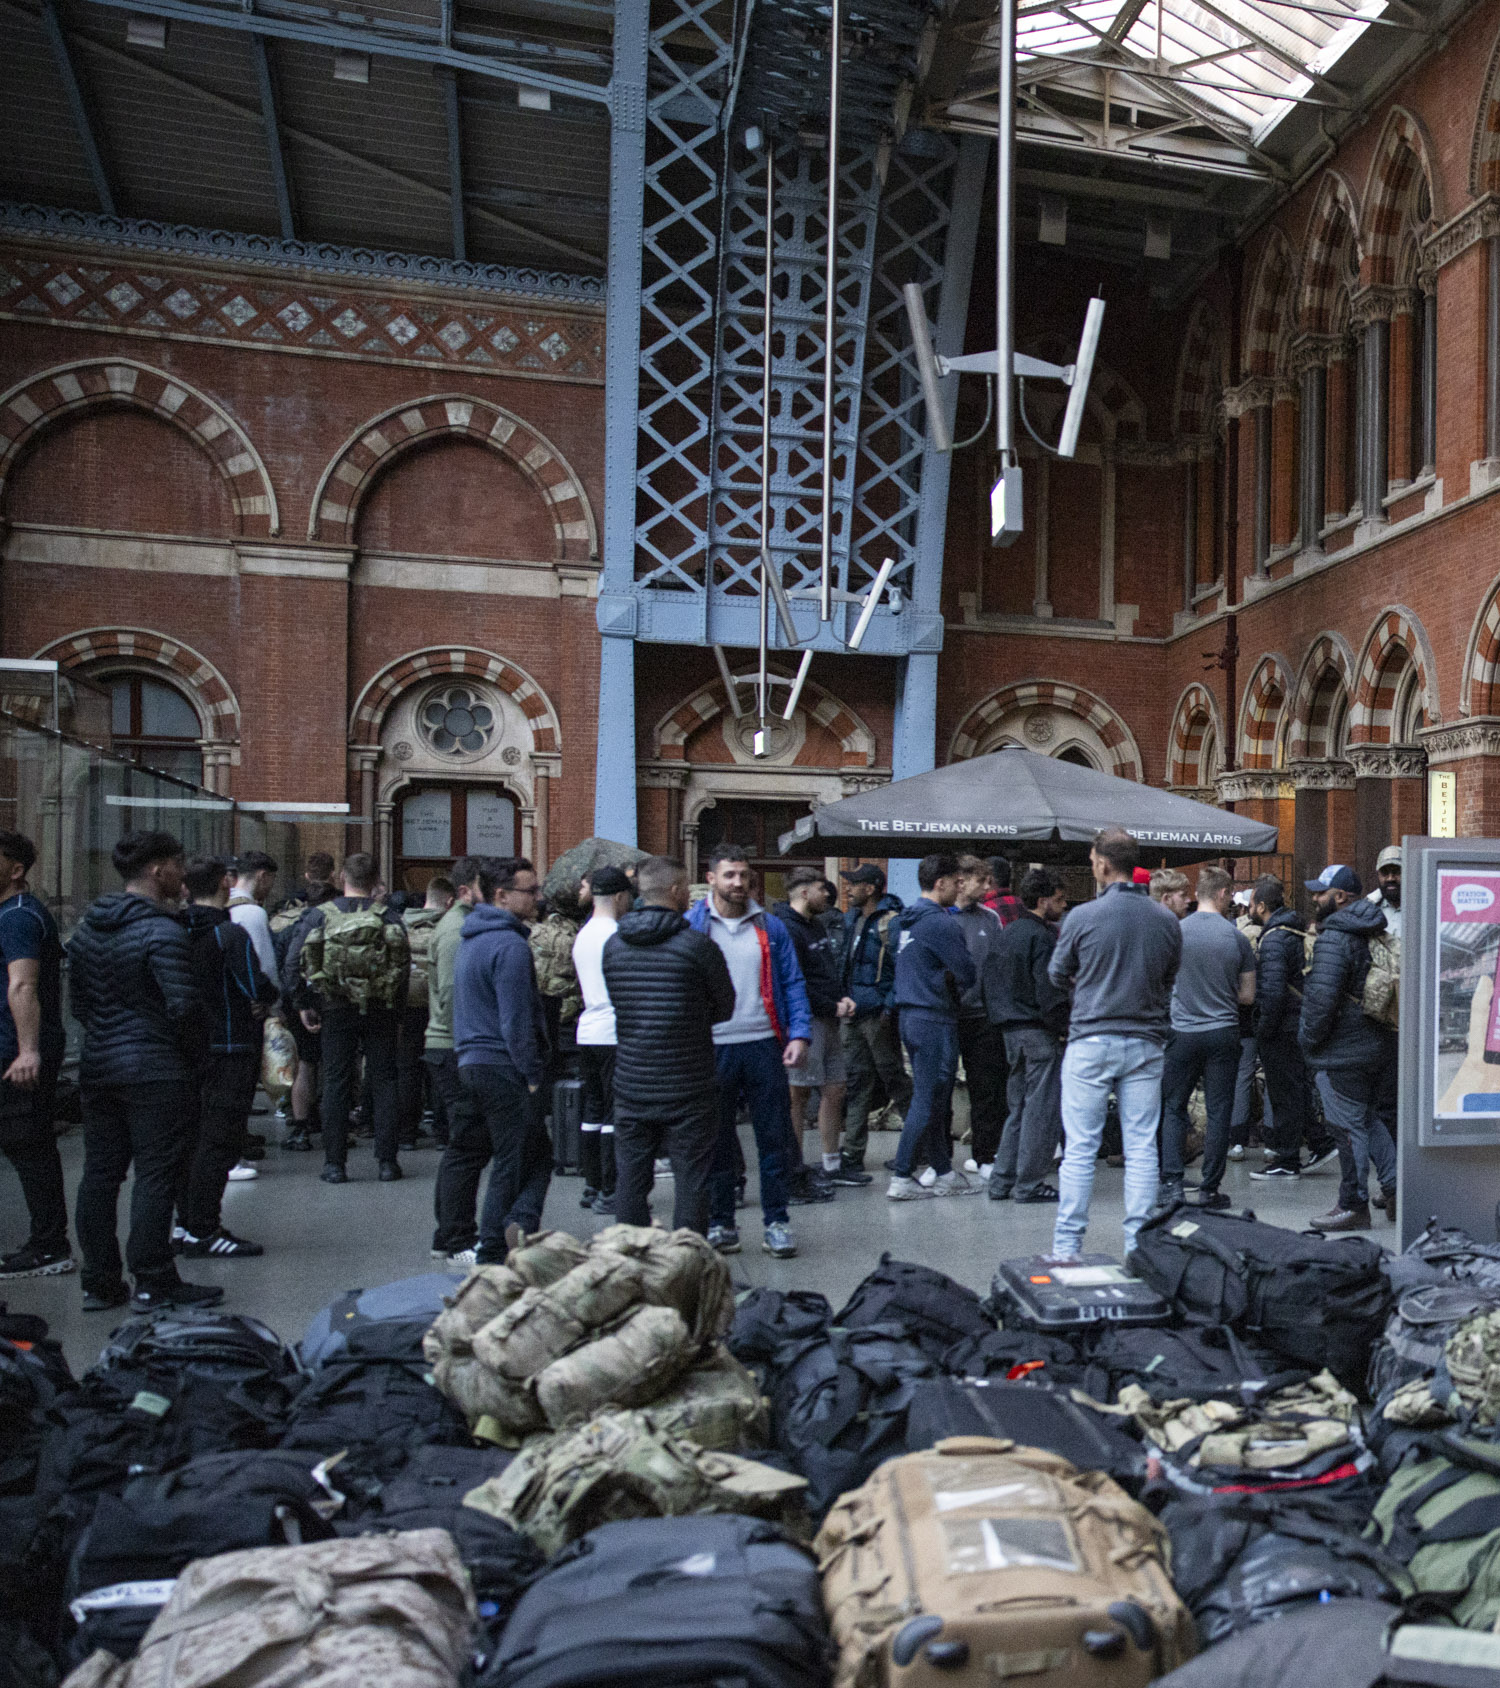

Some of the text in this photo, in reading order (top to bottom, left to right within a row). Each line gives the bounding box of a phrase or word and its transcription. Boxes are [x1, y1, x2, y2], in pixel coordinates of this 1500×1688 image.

[858, 819, 1018, 834] THE BETJEMAN ARMS
[1126, 829, 1242, 845] BETJEMAN ARMS
